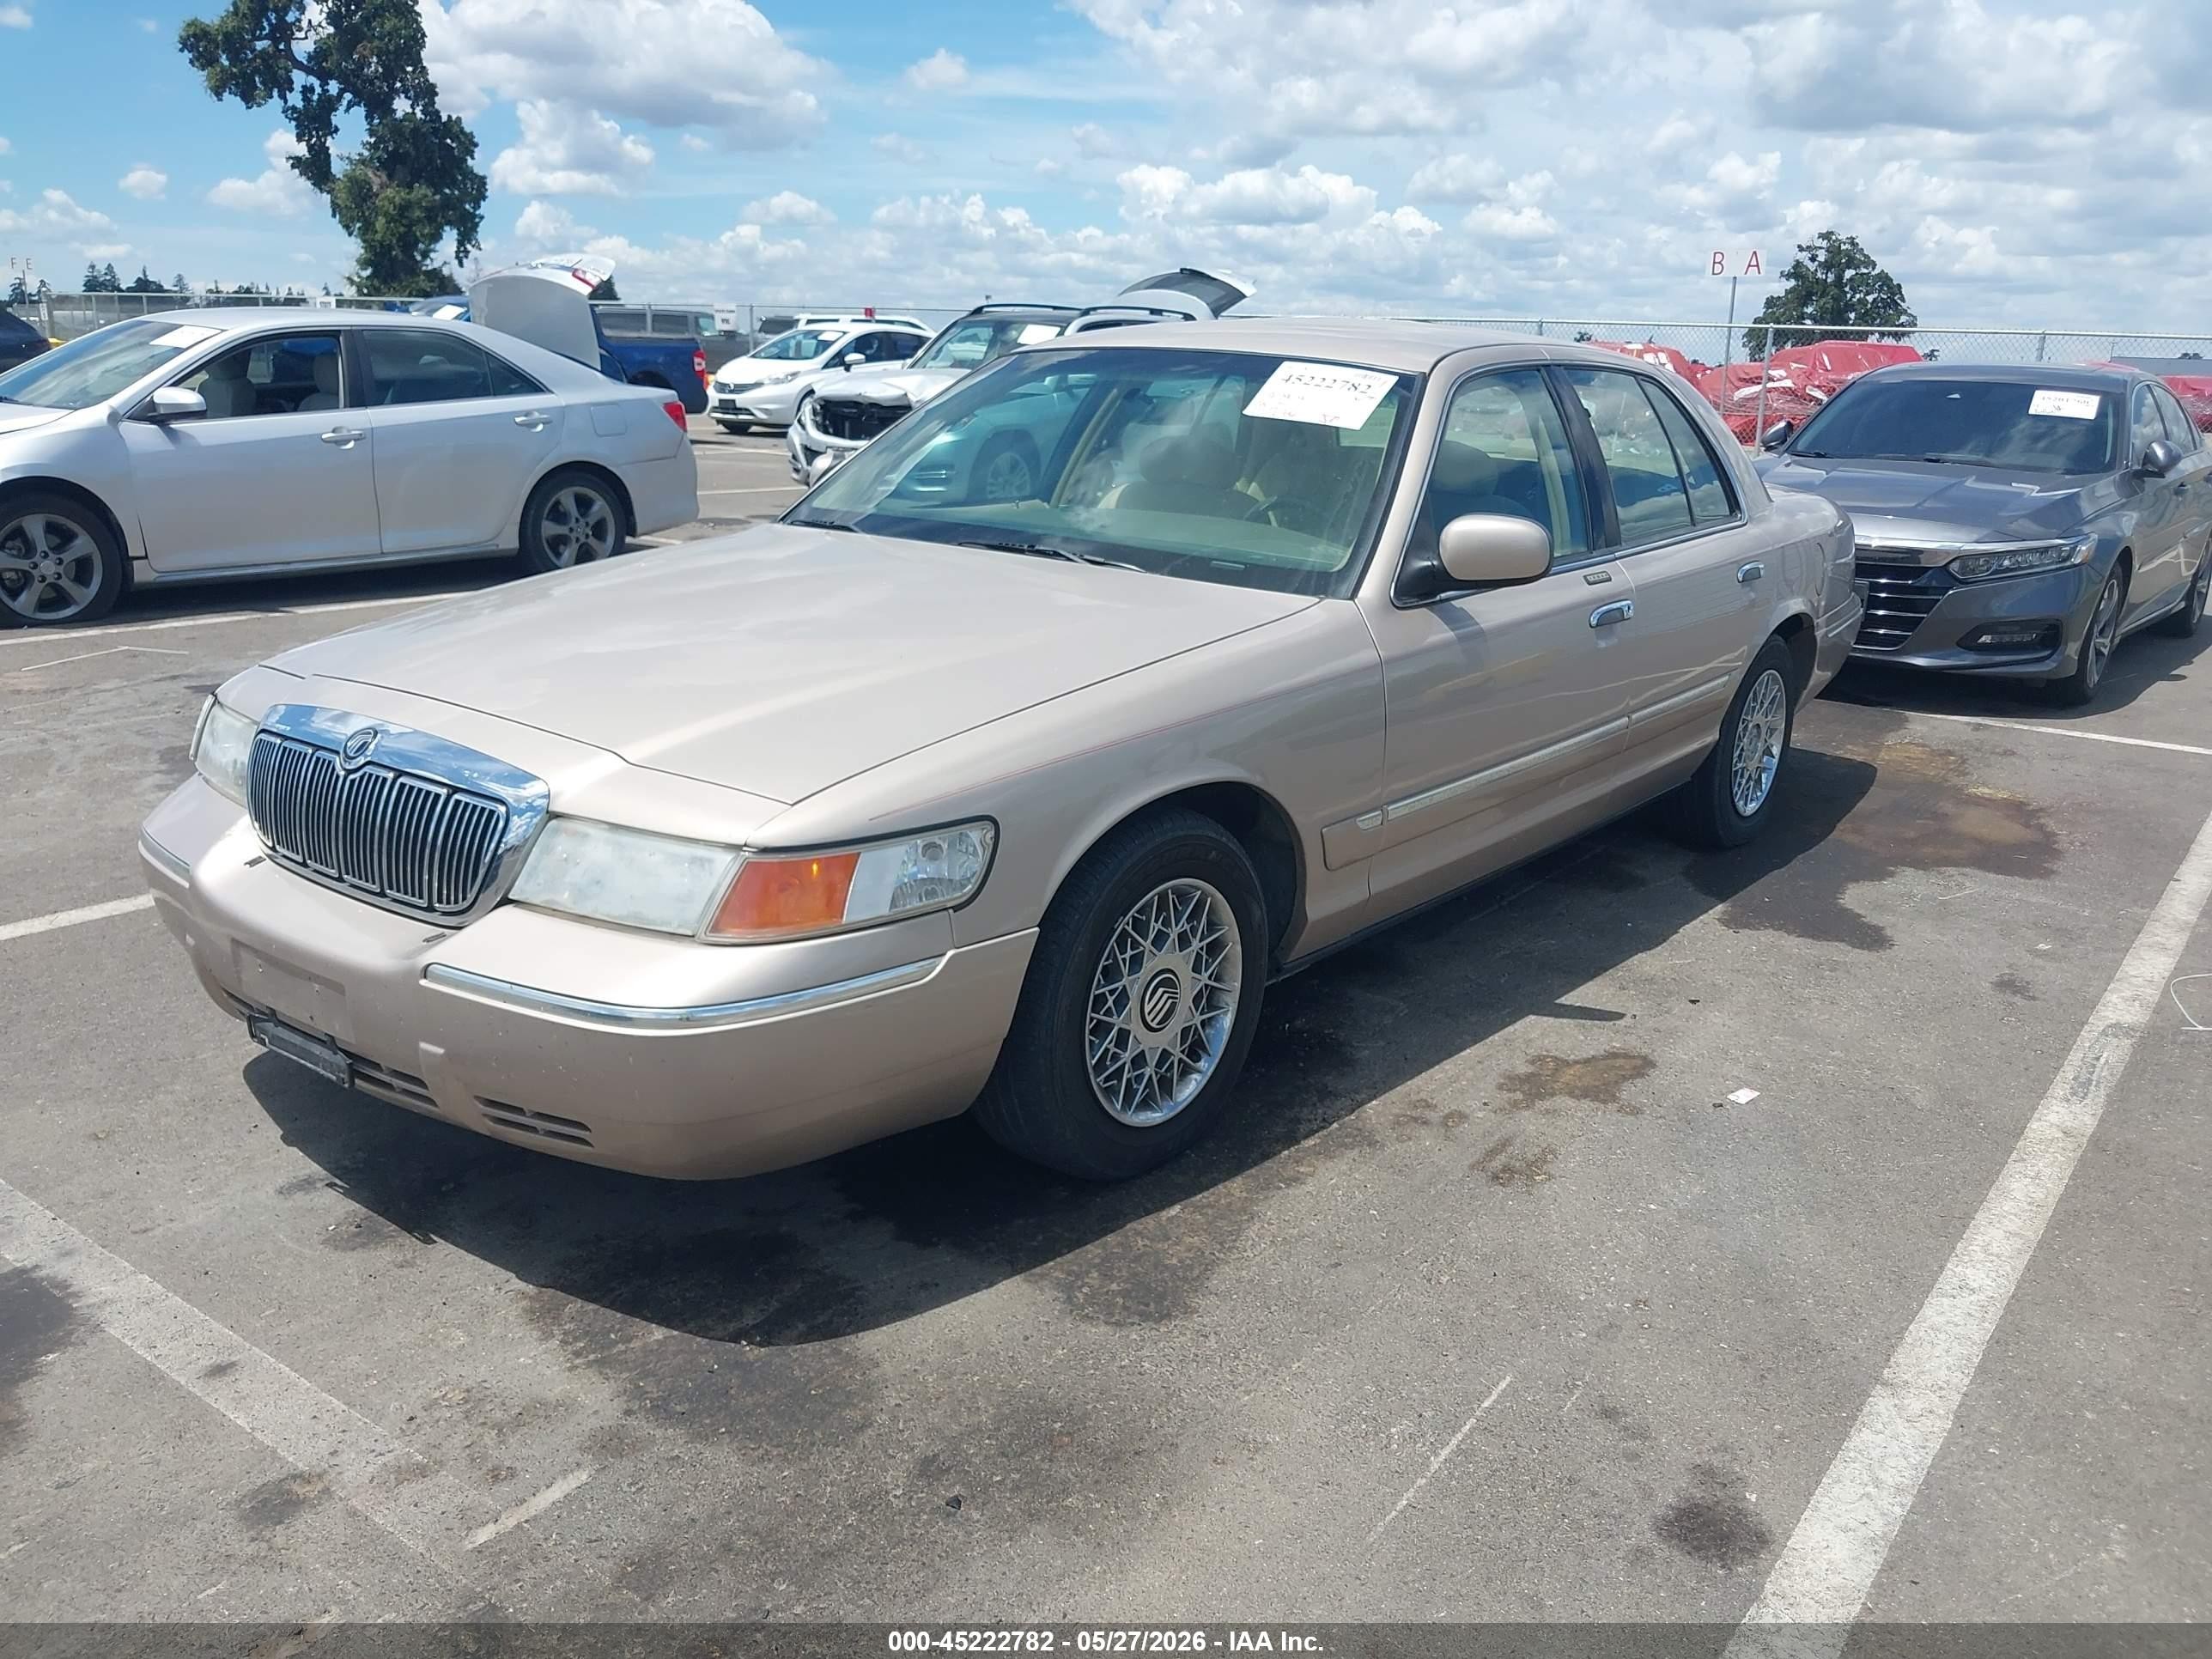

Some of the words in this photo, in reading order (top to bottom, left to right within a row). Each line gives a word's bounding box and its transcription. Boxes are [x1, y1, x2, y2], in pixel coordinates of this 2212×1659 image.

[10, 257, 17, 270] F
[26, 258, 33, 270] E
[1711, 251, 1725, 276] B
[1744, 250, 1761, 276] A
[1281, 373, 1372, 394] 45222782
